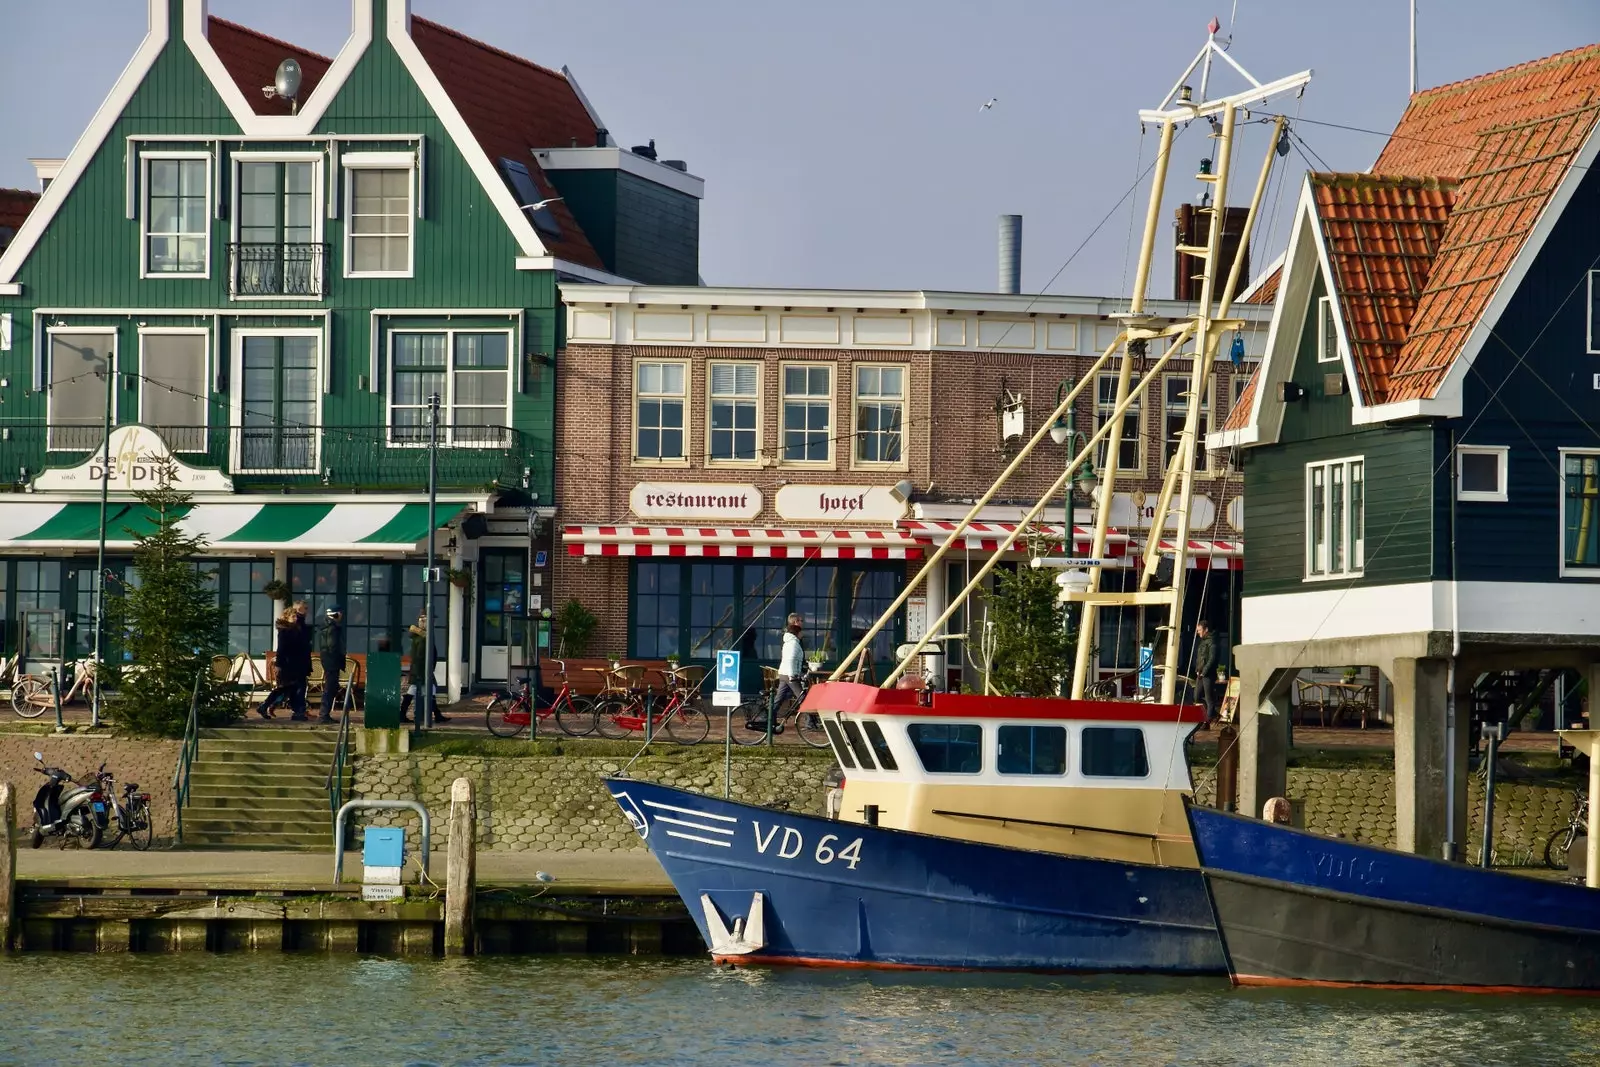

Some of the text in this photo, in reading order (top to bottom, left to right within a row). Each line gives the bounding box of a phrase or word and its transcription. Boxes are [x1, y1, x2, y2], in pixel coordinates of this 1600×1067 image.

[645, 492, 748, 508] restaurant
[819, 493, 864, 513] hotel
[721, 654, 735, 675] P
[752, 820, 864, 870] VD 64
